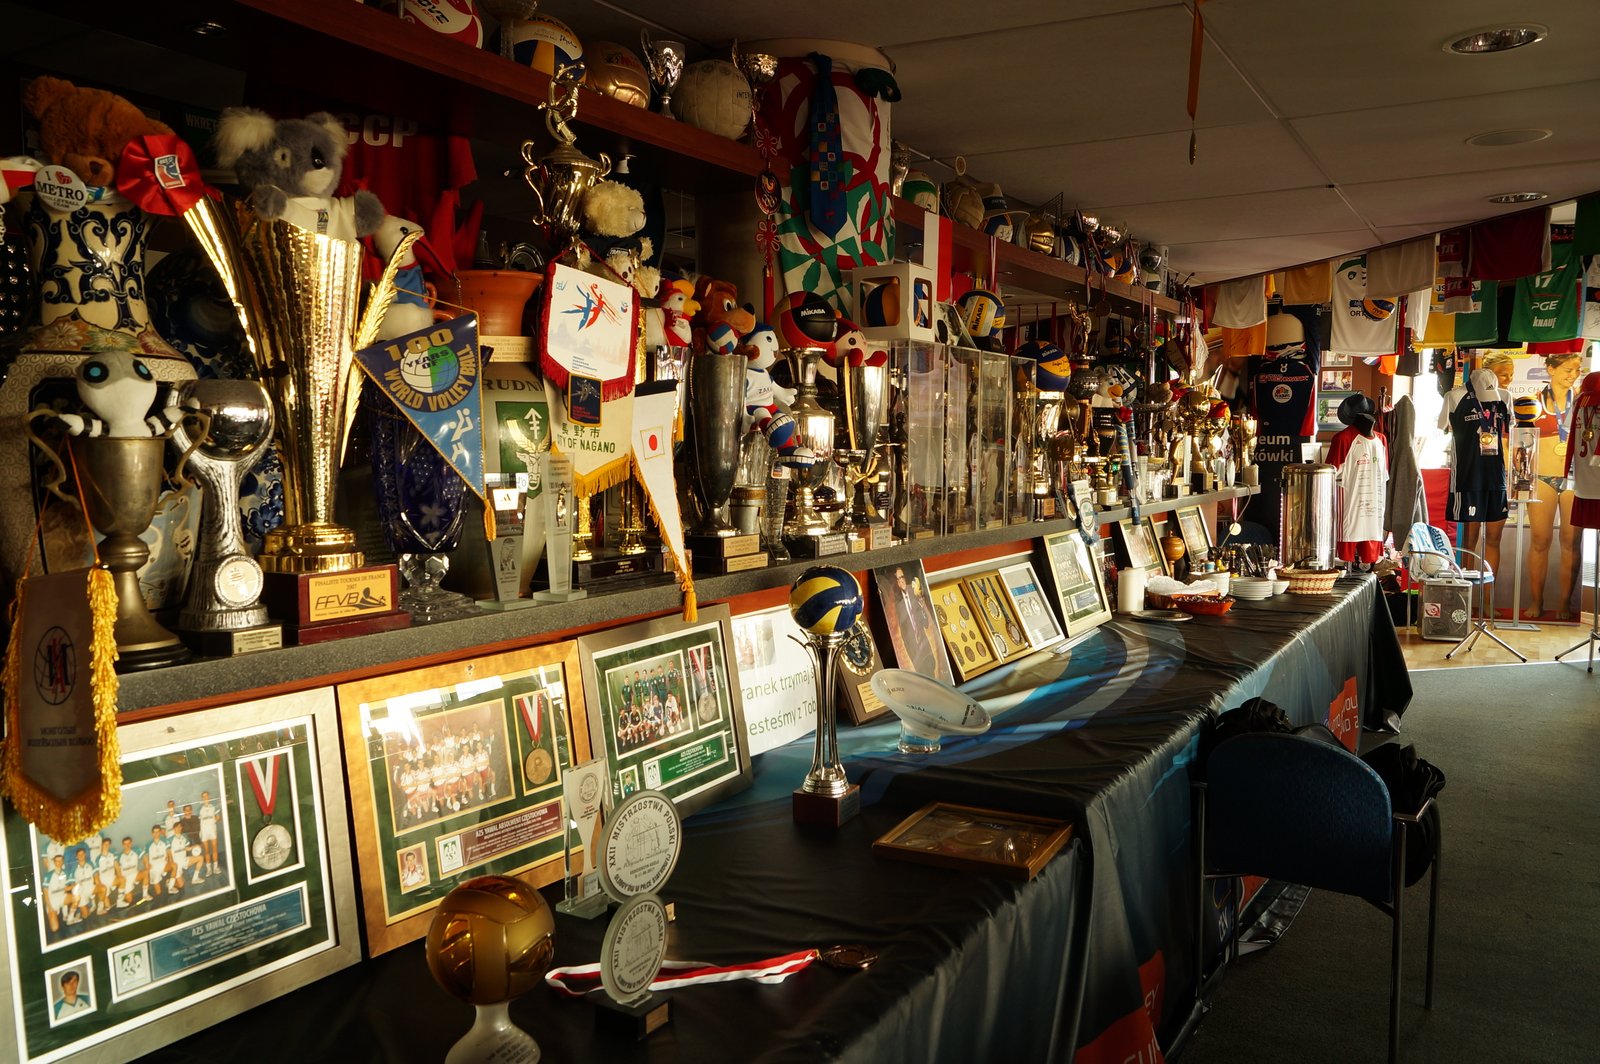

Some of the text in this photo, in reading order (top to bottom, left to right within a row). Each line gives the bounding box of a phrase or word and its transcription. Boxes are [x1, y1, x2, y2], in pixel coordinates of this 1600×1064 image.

[36, 181, 84, 201] METRO
[1535, 274, 1554, 288] 17
[800, 308, 826, 317] MIKASA
[1532, 300, 1559, 311] PGE
[384, 328, 454, 361] 100
[384, 368, 424, 409] WORLD
[568, 438, 577, 449] OF
[580, 440, 616, 454] NAGANO
[316, 592, 360, 610] FFVB
[780, 664, 810, 690] trzymaj
[749, 704, 796, 736] esteśmy
[798, 707, 802, 720] z
[612, 800, 663, 840] MISTRZOSTWA
[664, 810, 676, 845] POLSKI
[192, 926, 204, 937] AZS
[204, 918, 226, 933] YAWAL
[617, 904, 655, 944] MISTRZOSTWA
